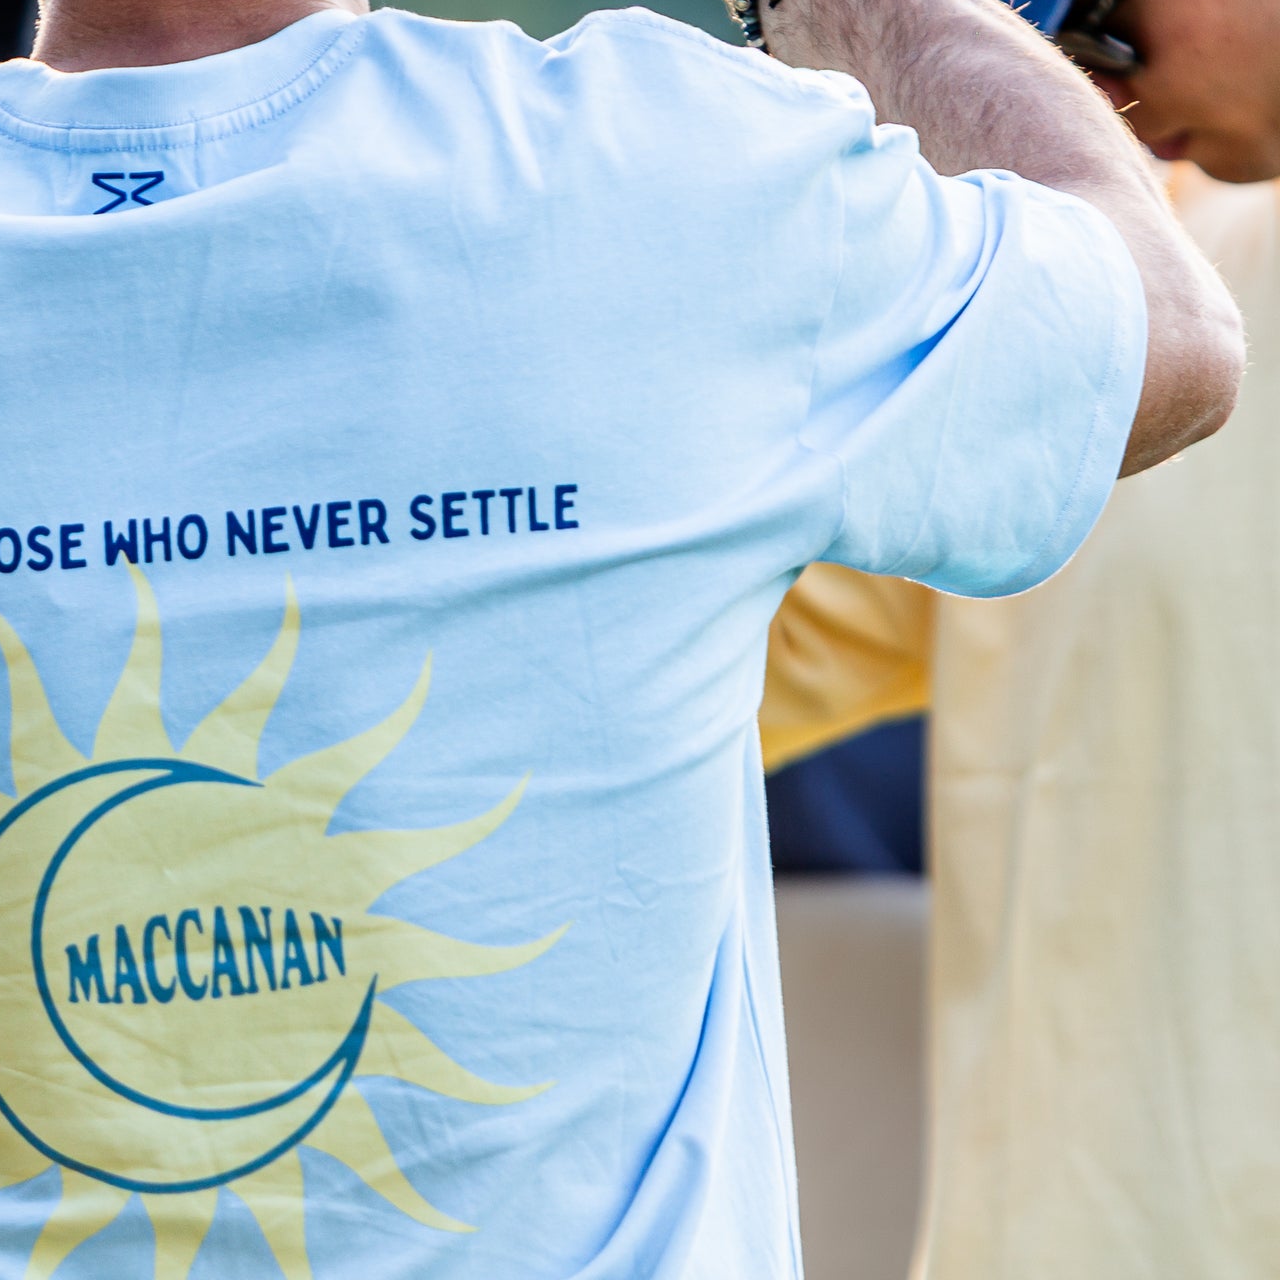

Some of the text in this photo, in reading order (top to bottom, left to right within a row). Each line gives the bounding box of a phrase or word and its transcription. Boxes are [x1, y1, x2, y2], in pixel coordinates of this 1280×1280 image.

[103, 513, 209, 567] WHO
[225, 498, 390, 557] NEVER
[409, 483, 580, 541] SETTLE
[64, 905, 347, 1005] MACCANAN
